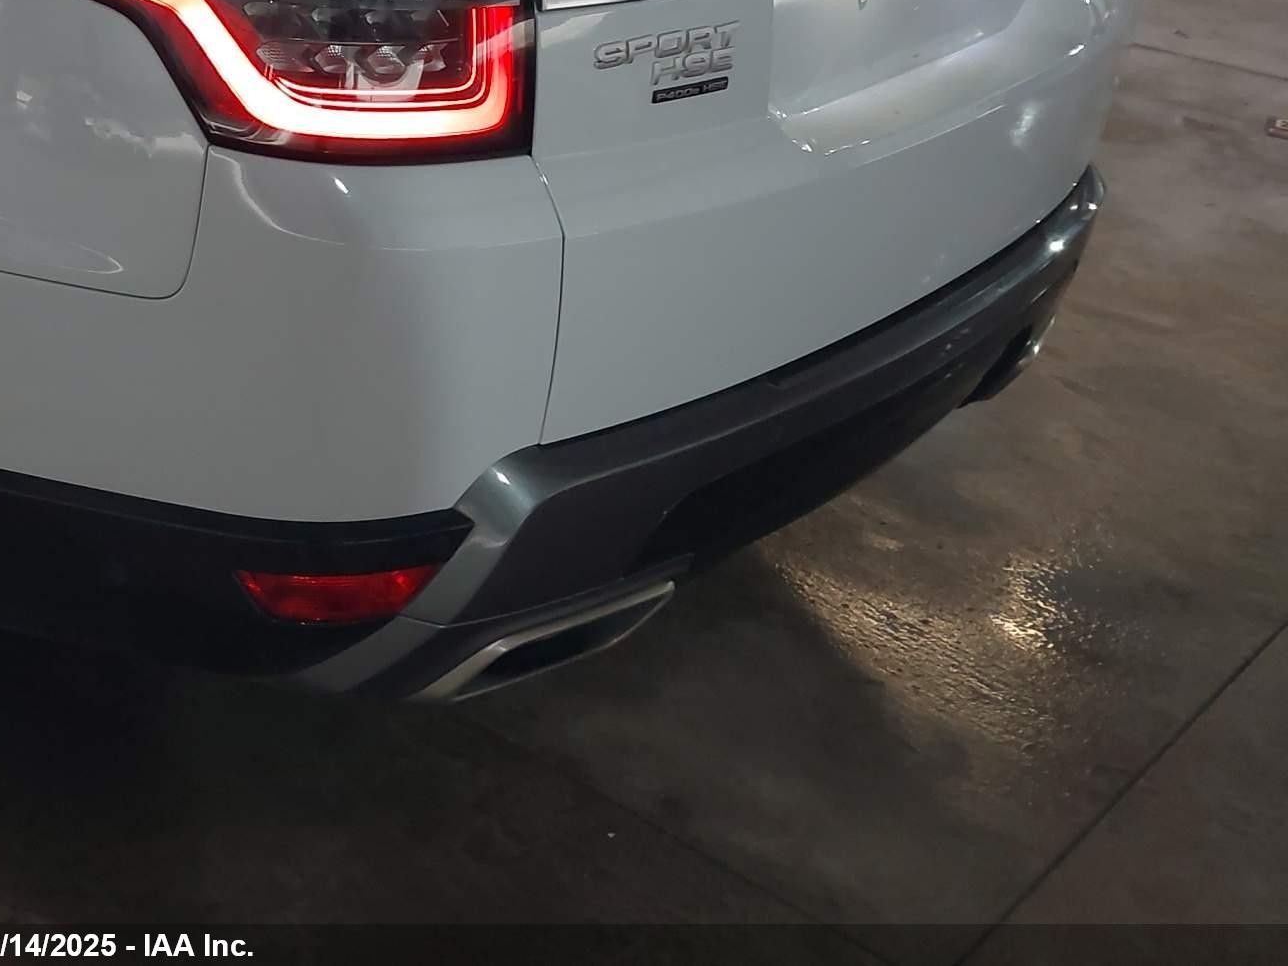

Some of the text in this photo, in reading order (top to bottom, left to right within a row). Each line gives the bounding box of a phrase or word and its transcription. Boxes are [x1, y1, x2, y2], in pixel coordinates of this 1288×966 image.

[593, 20, 740, 70] SPORT
[651, 46, 734, 85] HSE
[656, 87, 700, 102] P400e
